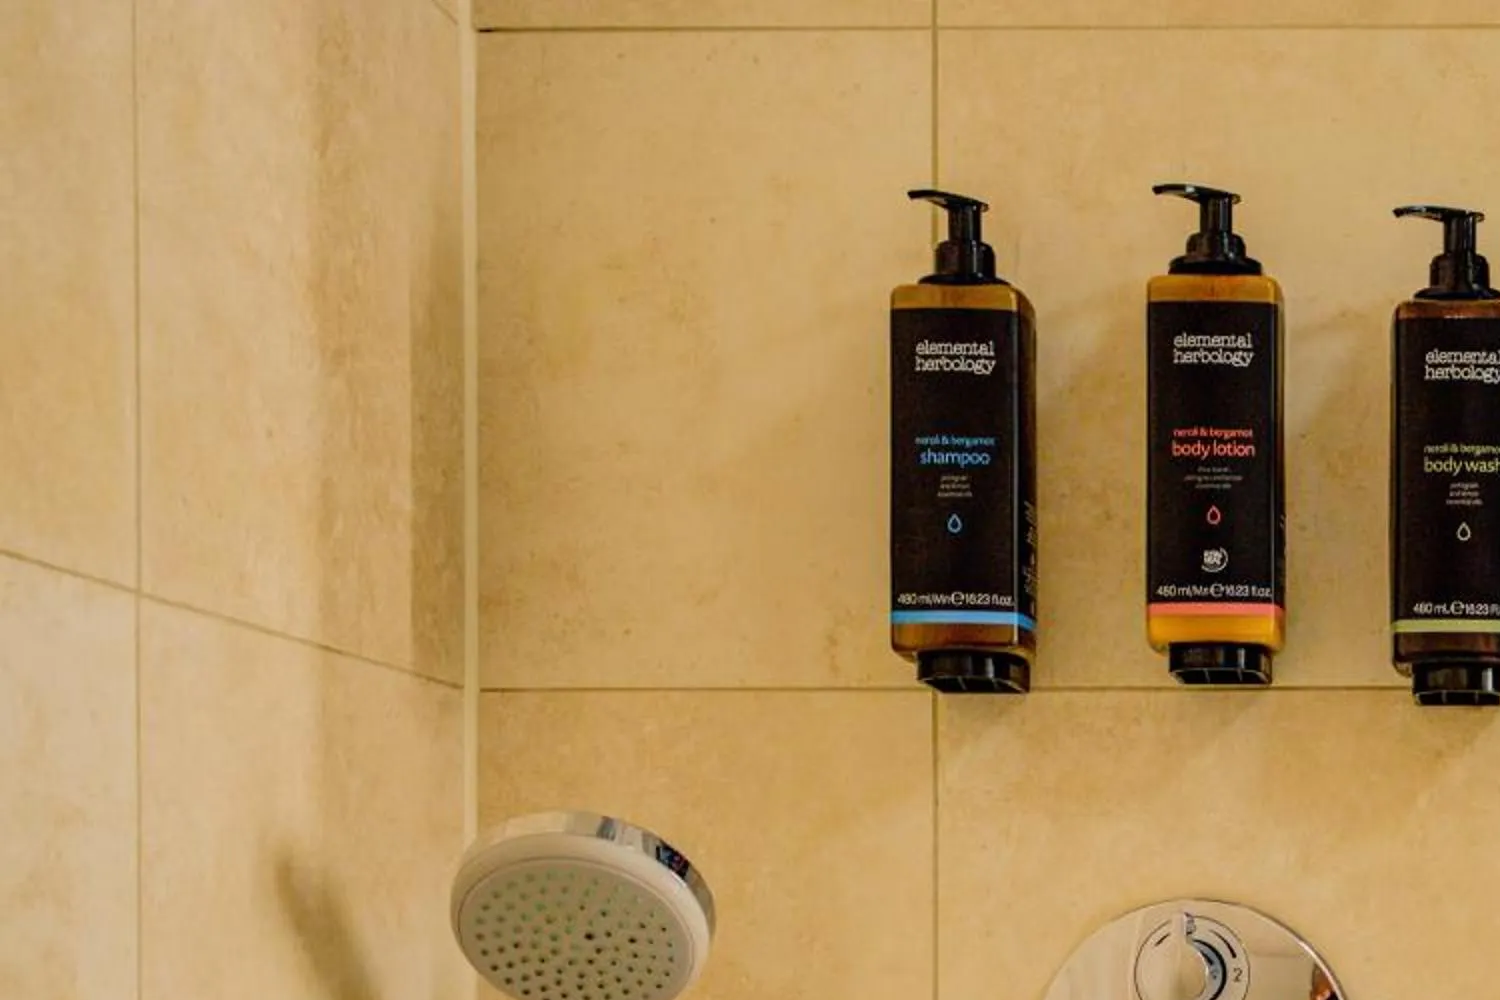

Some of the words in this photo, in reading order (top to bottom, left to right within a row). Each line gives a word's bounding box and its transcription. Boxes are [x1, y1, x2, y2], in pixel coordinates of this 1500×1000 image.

[915, 339, 995, 356] elemental
[1173, 331, 1253, 349] elemental
[914, 356, 997, 375] herbology
[1173, 348, 1255, 367] herbology
[919, 448, 991, 468] shampoo
[1172, 439, 1211, 461] body
[1213, 439, 1256, 458] lotion
[1424, 455, 1462, 477] body
[1233, 967, 1243, 983] 2
